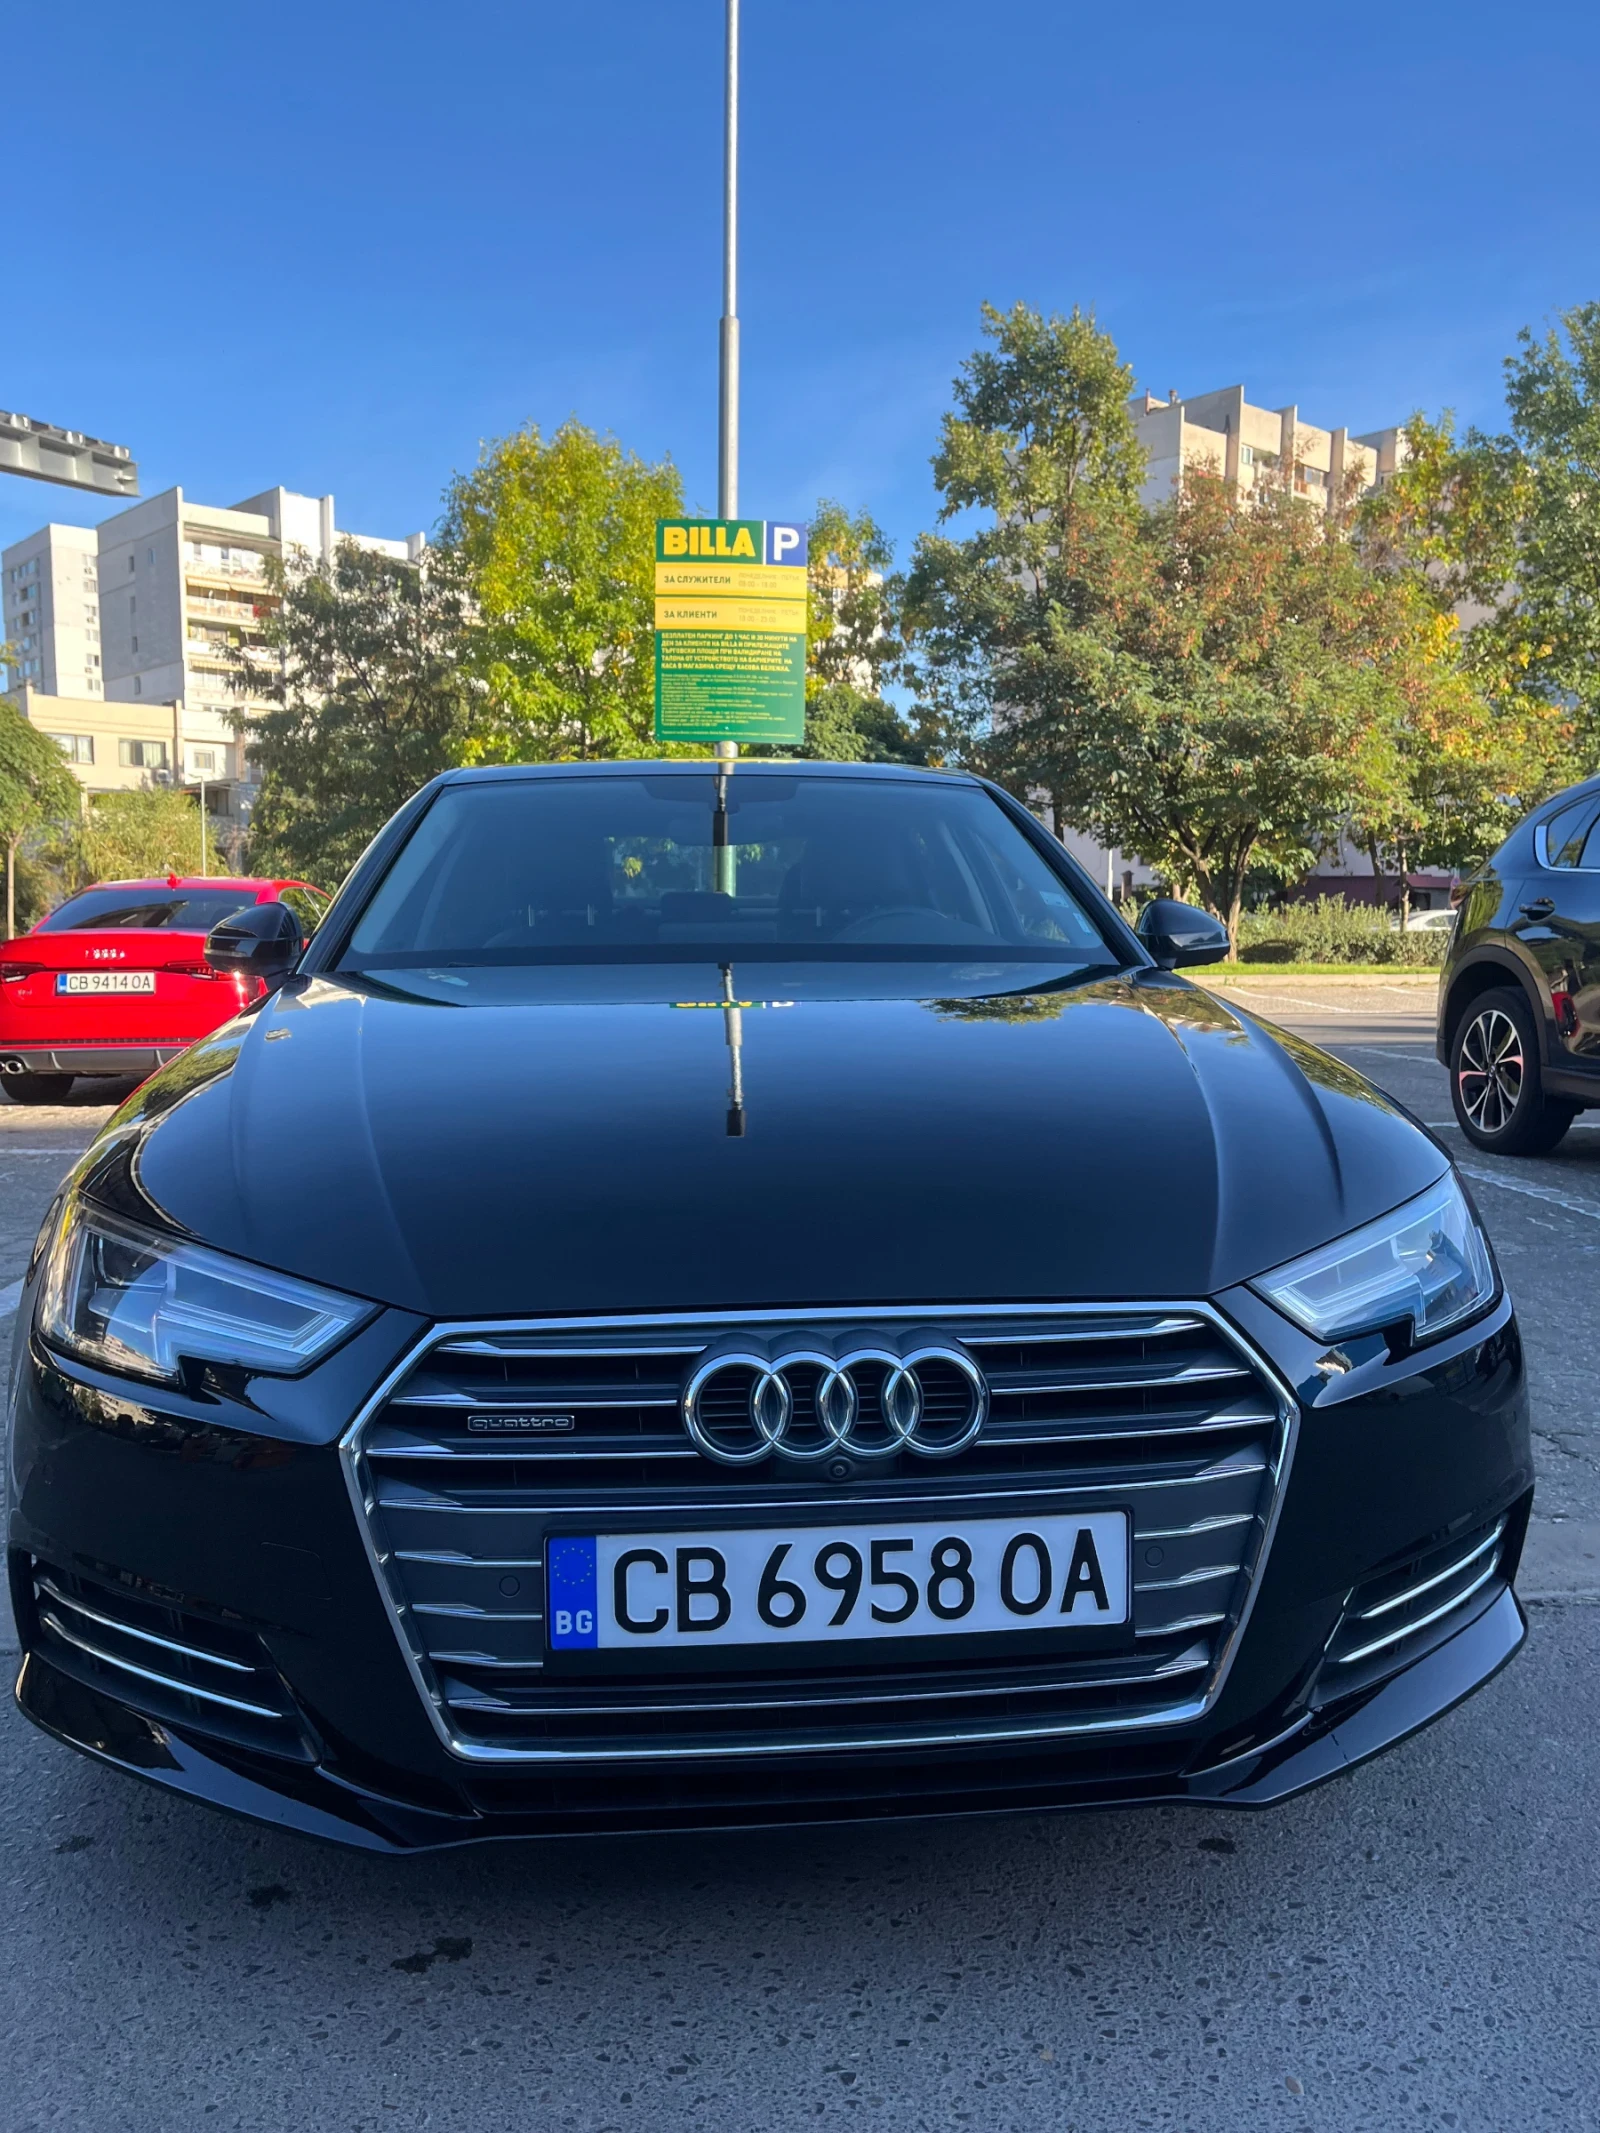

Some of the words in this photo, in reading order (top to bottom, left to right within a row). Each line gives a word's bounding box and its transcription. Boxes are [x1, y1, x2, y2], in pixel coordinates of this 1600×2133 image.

[664, 527, 756, 556] BILLA
[774, 527, 799, 560] P
[69, 976, 88, 989] CB
[93, 976, 128, 989] 9414
[132, 976, 150, 989] OA
[473, 1418, 569, 1429] quattro
[614, 1546, 732, 1634] CB
[756, 1536, 975, 1628] 6958
[1000, 1528, 1110, 1616] OA
[556, 1610, 592, 1634] BG
